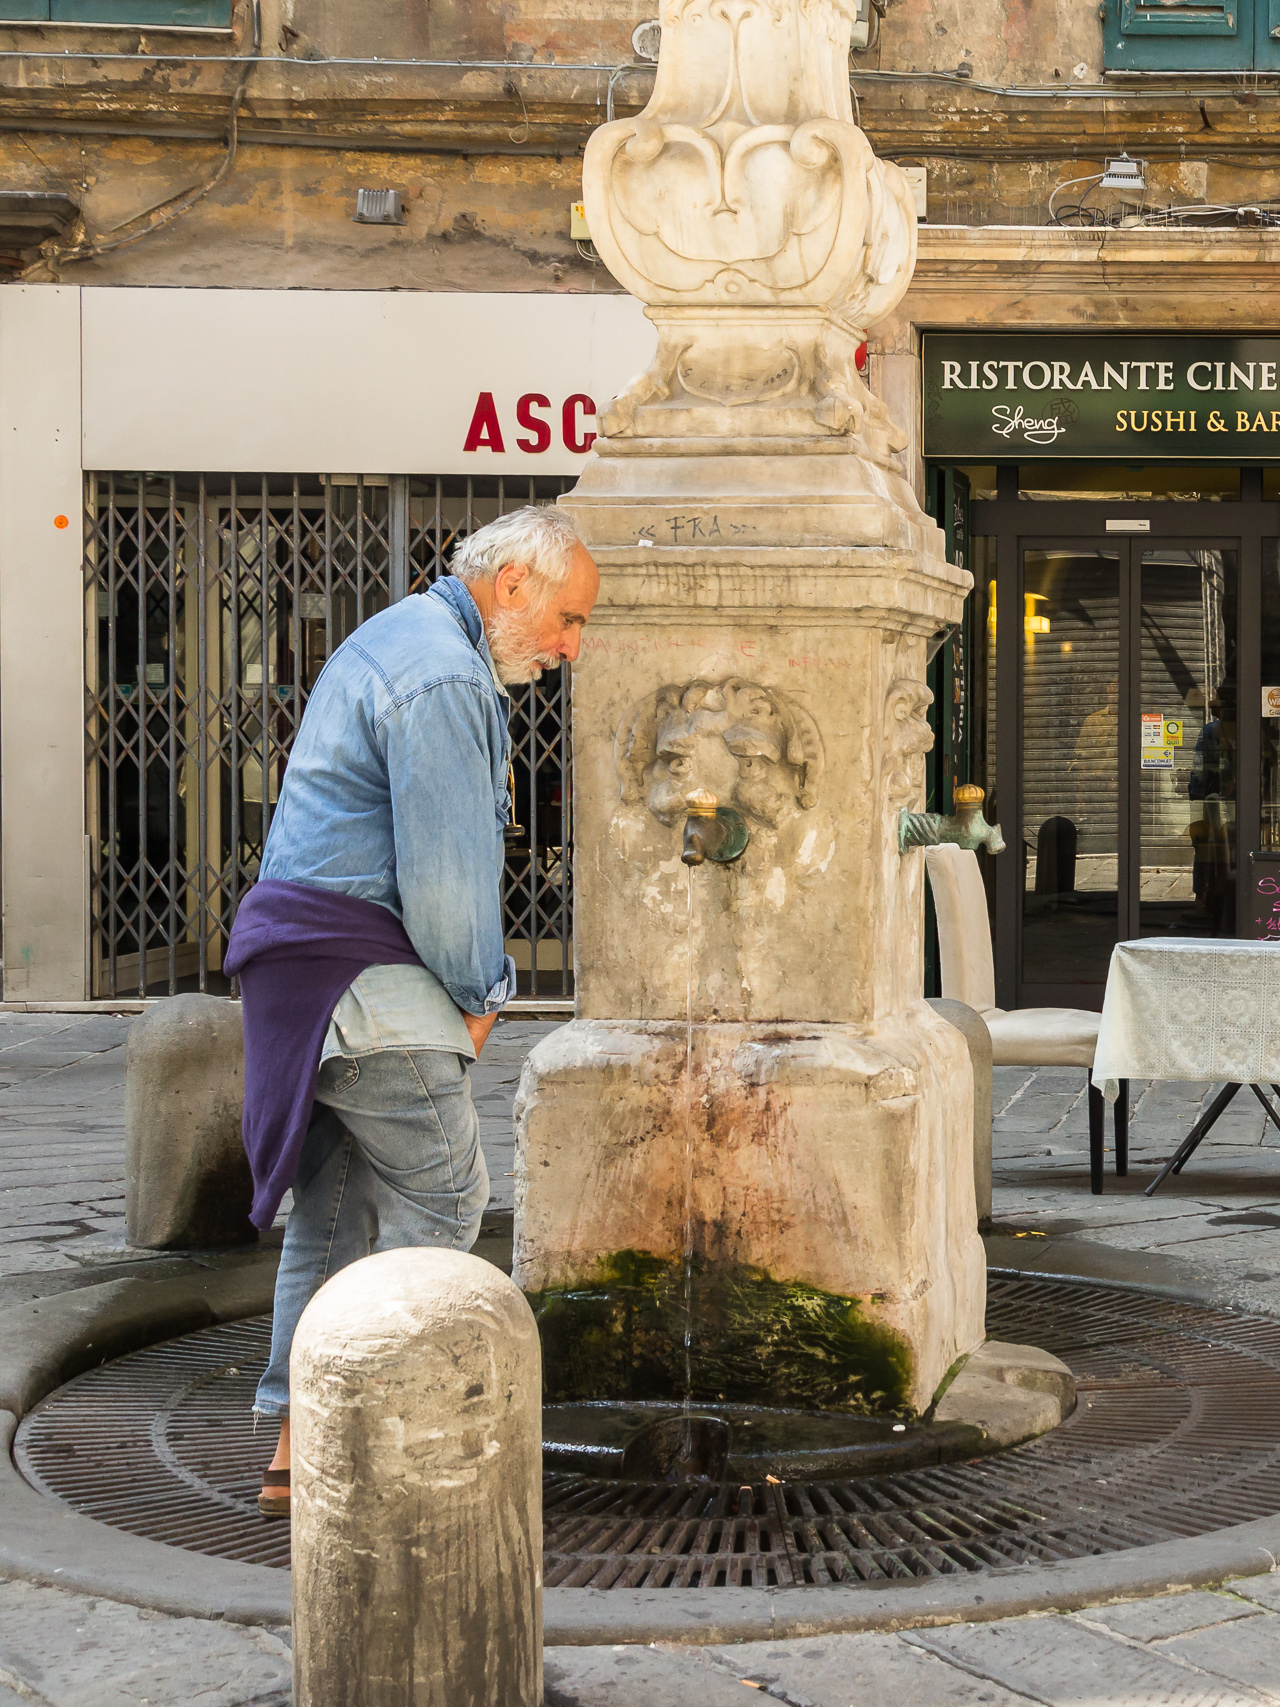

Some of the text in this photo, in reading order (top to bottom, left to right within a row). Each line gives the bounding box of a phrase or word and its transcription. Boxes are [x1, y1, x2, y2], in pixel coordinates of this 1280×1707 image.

[941, 360, 1174, 391] RISTORANTE
[462, 391, 600, 454] ASC
[991, 404, 1067, 444] Sheng
[1115, 410, 1197, 432] SUSHI
[1207, 411, 1228, 432] &
[666, 515, 722, 543] FRA
